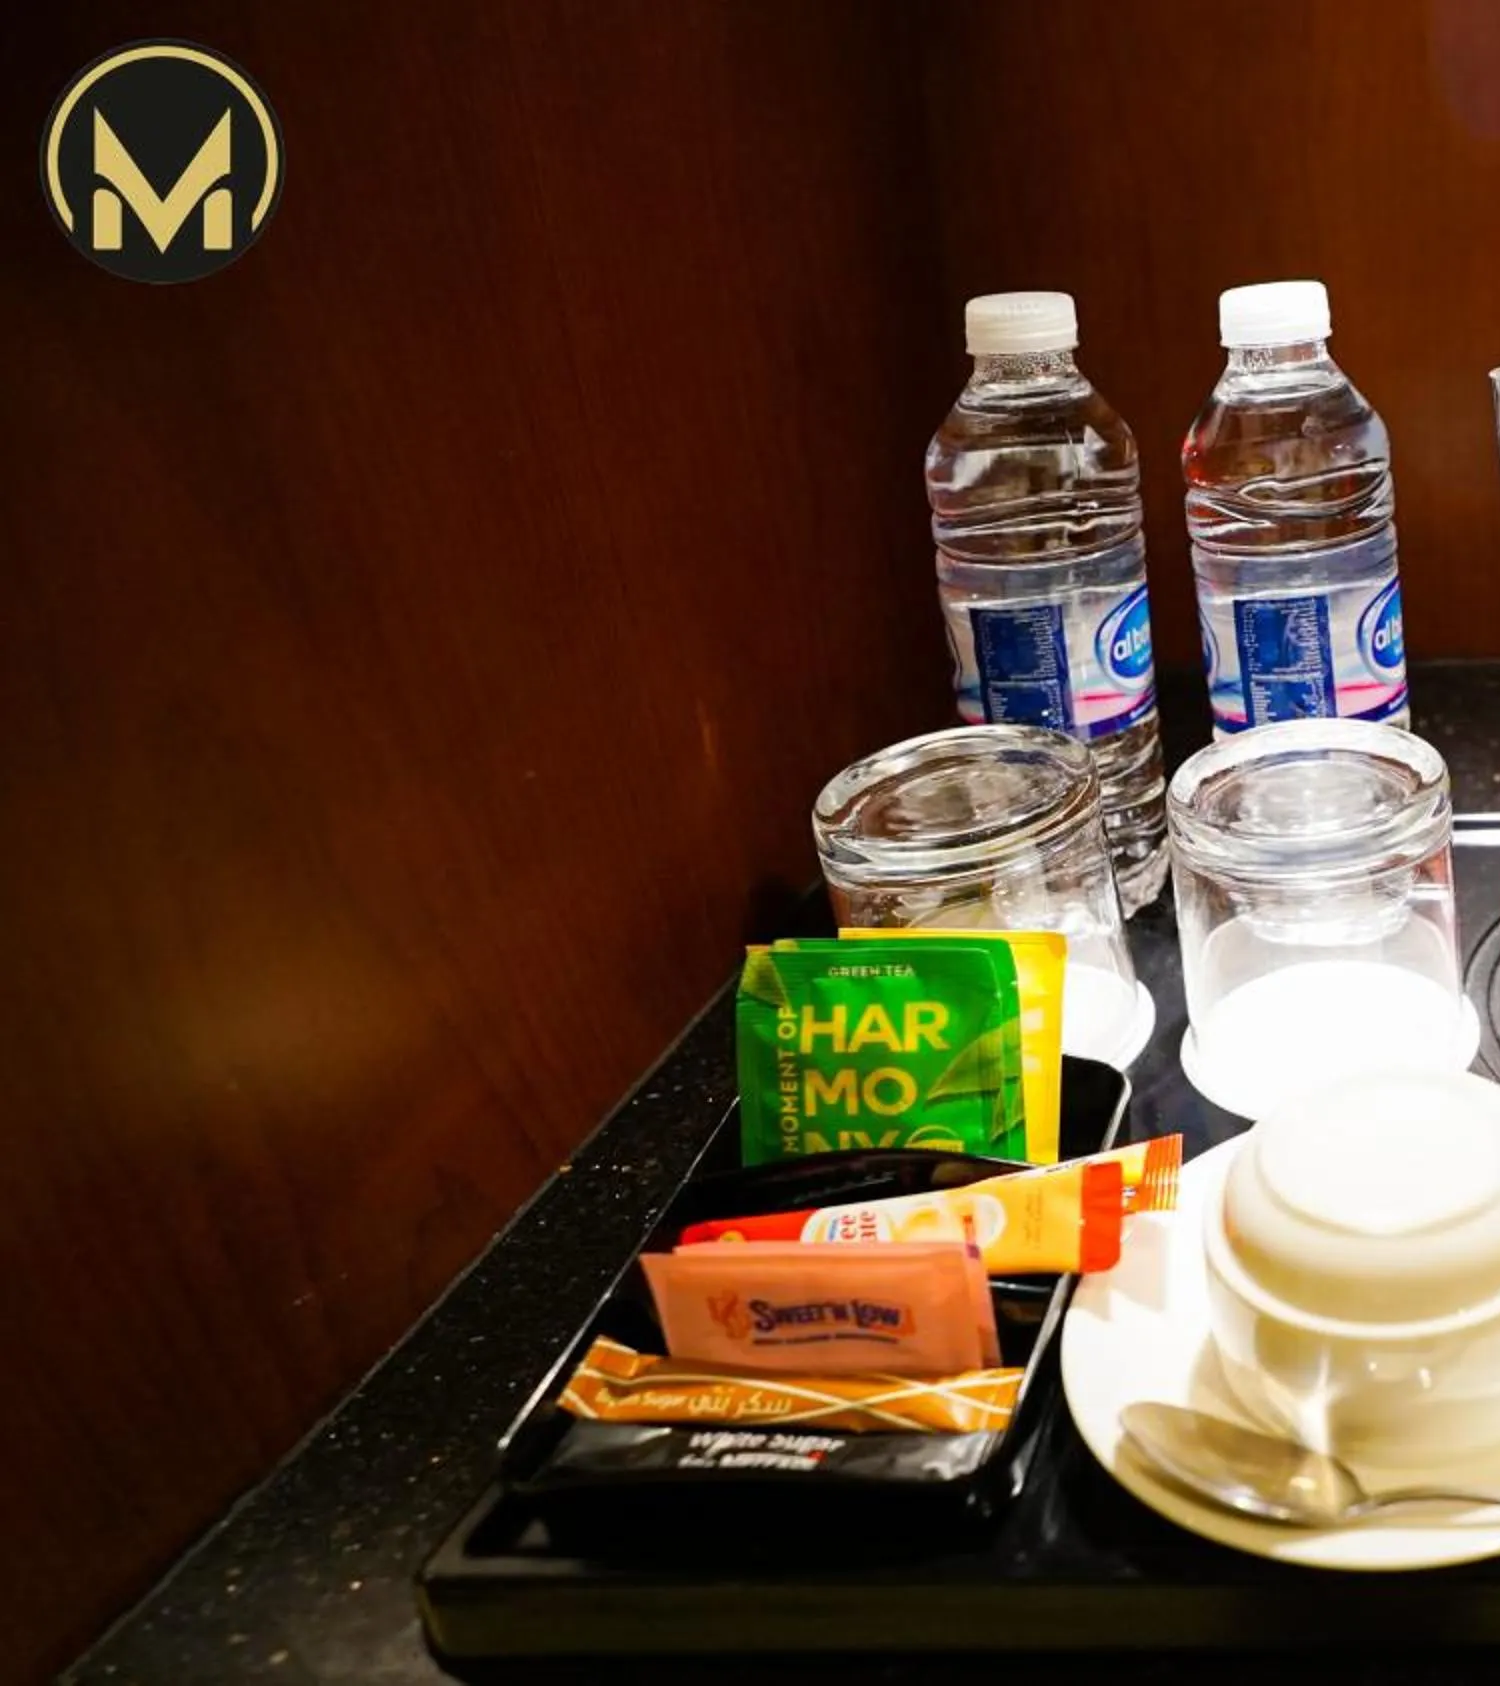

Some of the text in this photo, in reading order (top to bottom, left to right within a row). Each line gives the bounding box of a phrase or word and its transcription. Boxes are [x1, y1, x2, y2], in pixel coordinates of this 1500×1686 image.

[828, 963, 916, 977] GREEN TEA
[800, 1001, 951, 1055] HAR
[776, 1006, 798, 1153] MOMENT OF
[803, 1066, 918, 1118] MO
